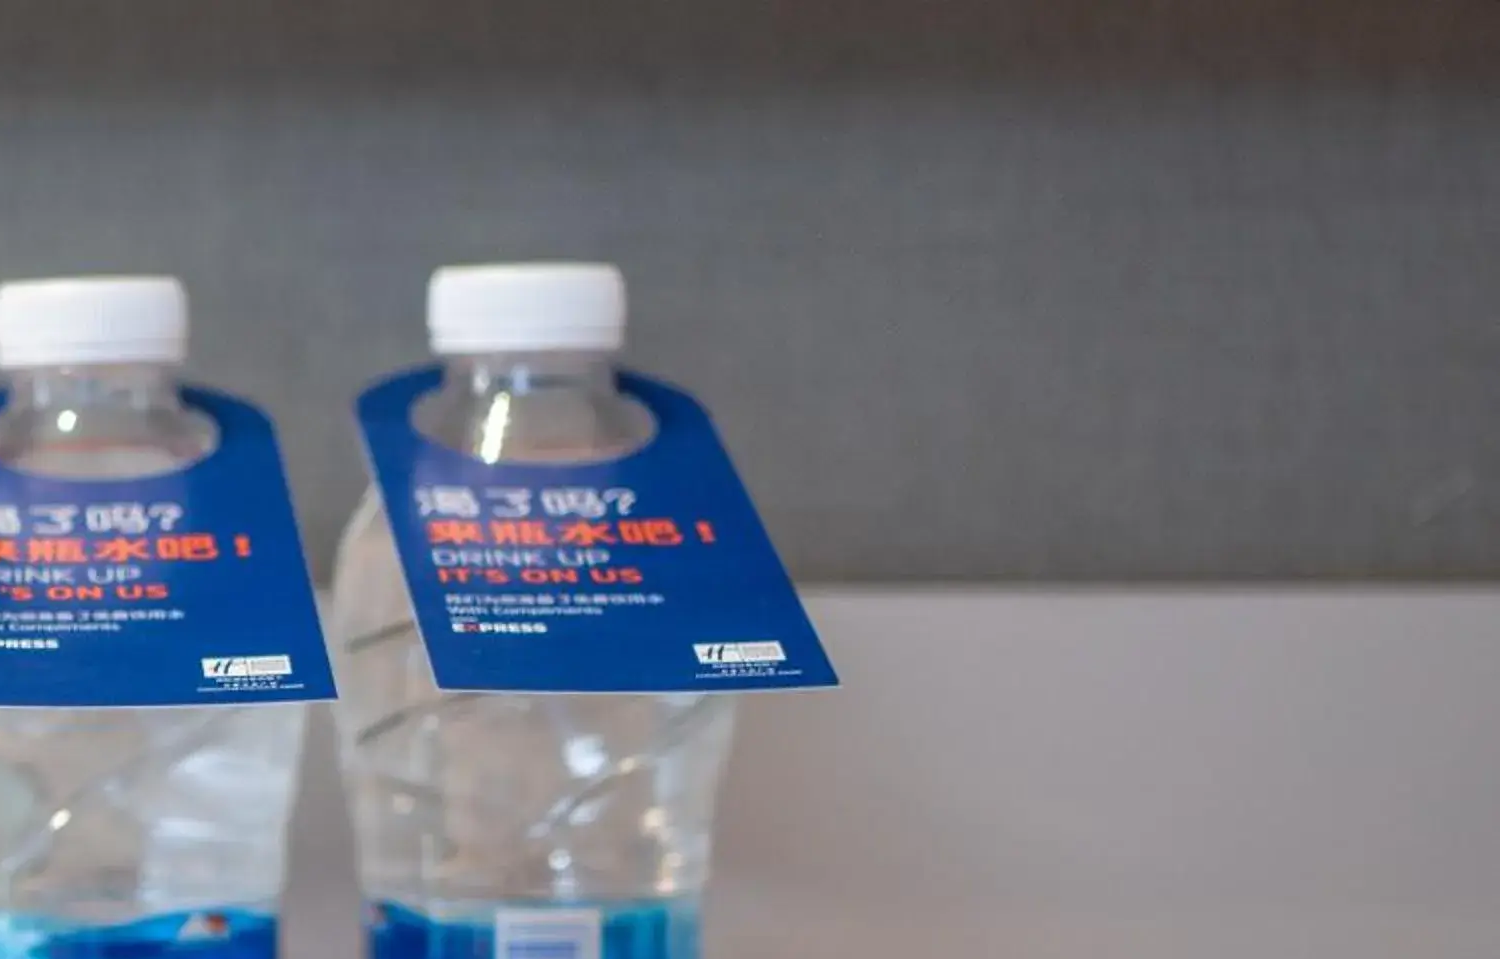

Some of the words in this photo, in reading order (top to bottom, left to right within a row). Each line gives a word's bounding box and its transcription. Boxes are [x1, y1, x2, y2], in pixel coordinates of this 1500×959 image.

[432, 547, 546, 567] DRINK
[557, 547, 610, 567] UP
[88, 566, 142, 584] UP
[437, 568, 509, 584] IT'S
[520, 568, 578, 583] ON
[590, 568, 642, 583] US
[46, 585, 103, 600] ON
[116, 584, 169, 599] US
[452, 621, 548, 634] EXPRESS
